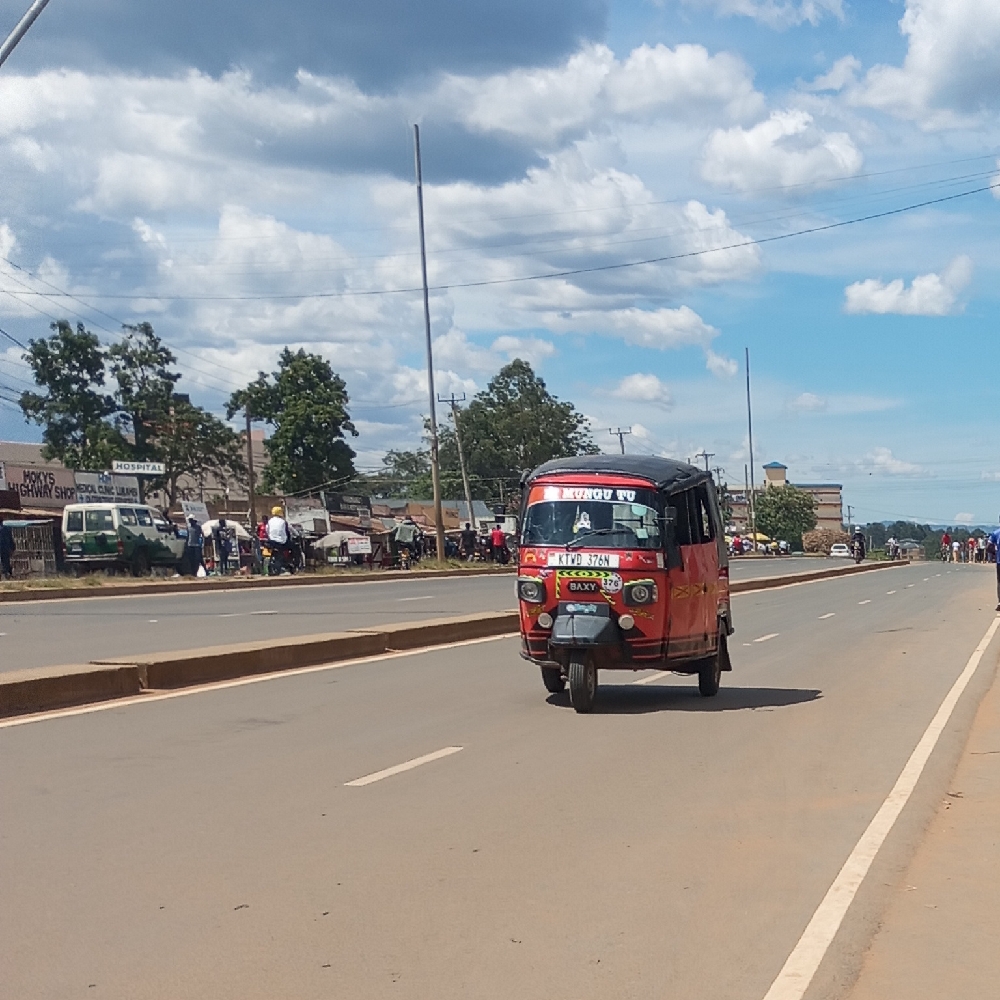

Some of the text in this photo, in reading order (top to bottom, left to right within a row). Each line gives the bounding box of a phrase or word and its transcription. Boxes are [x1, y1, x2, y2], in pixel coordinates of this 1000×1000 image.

[116, 462, 162, 472] HOSPITAL
[23, 469, 56, 485] HOKYS
[8, 481, 54, 499] HIGHWAY
[54, 486, 76, 500] SHOP
[562, 487, 613, 500] MUNGU
[616, 489, 636, 501] TU
[558, 553, 610, 567] KTWD 376N
[603, 577, 619, 588] 376
